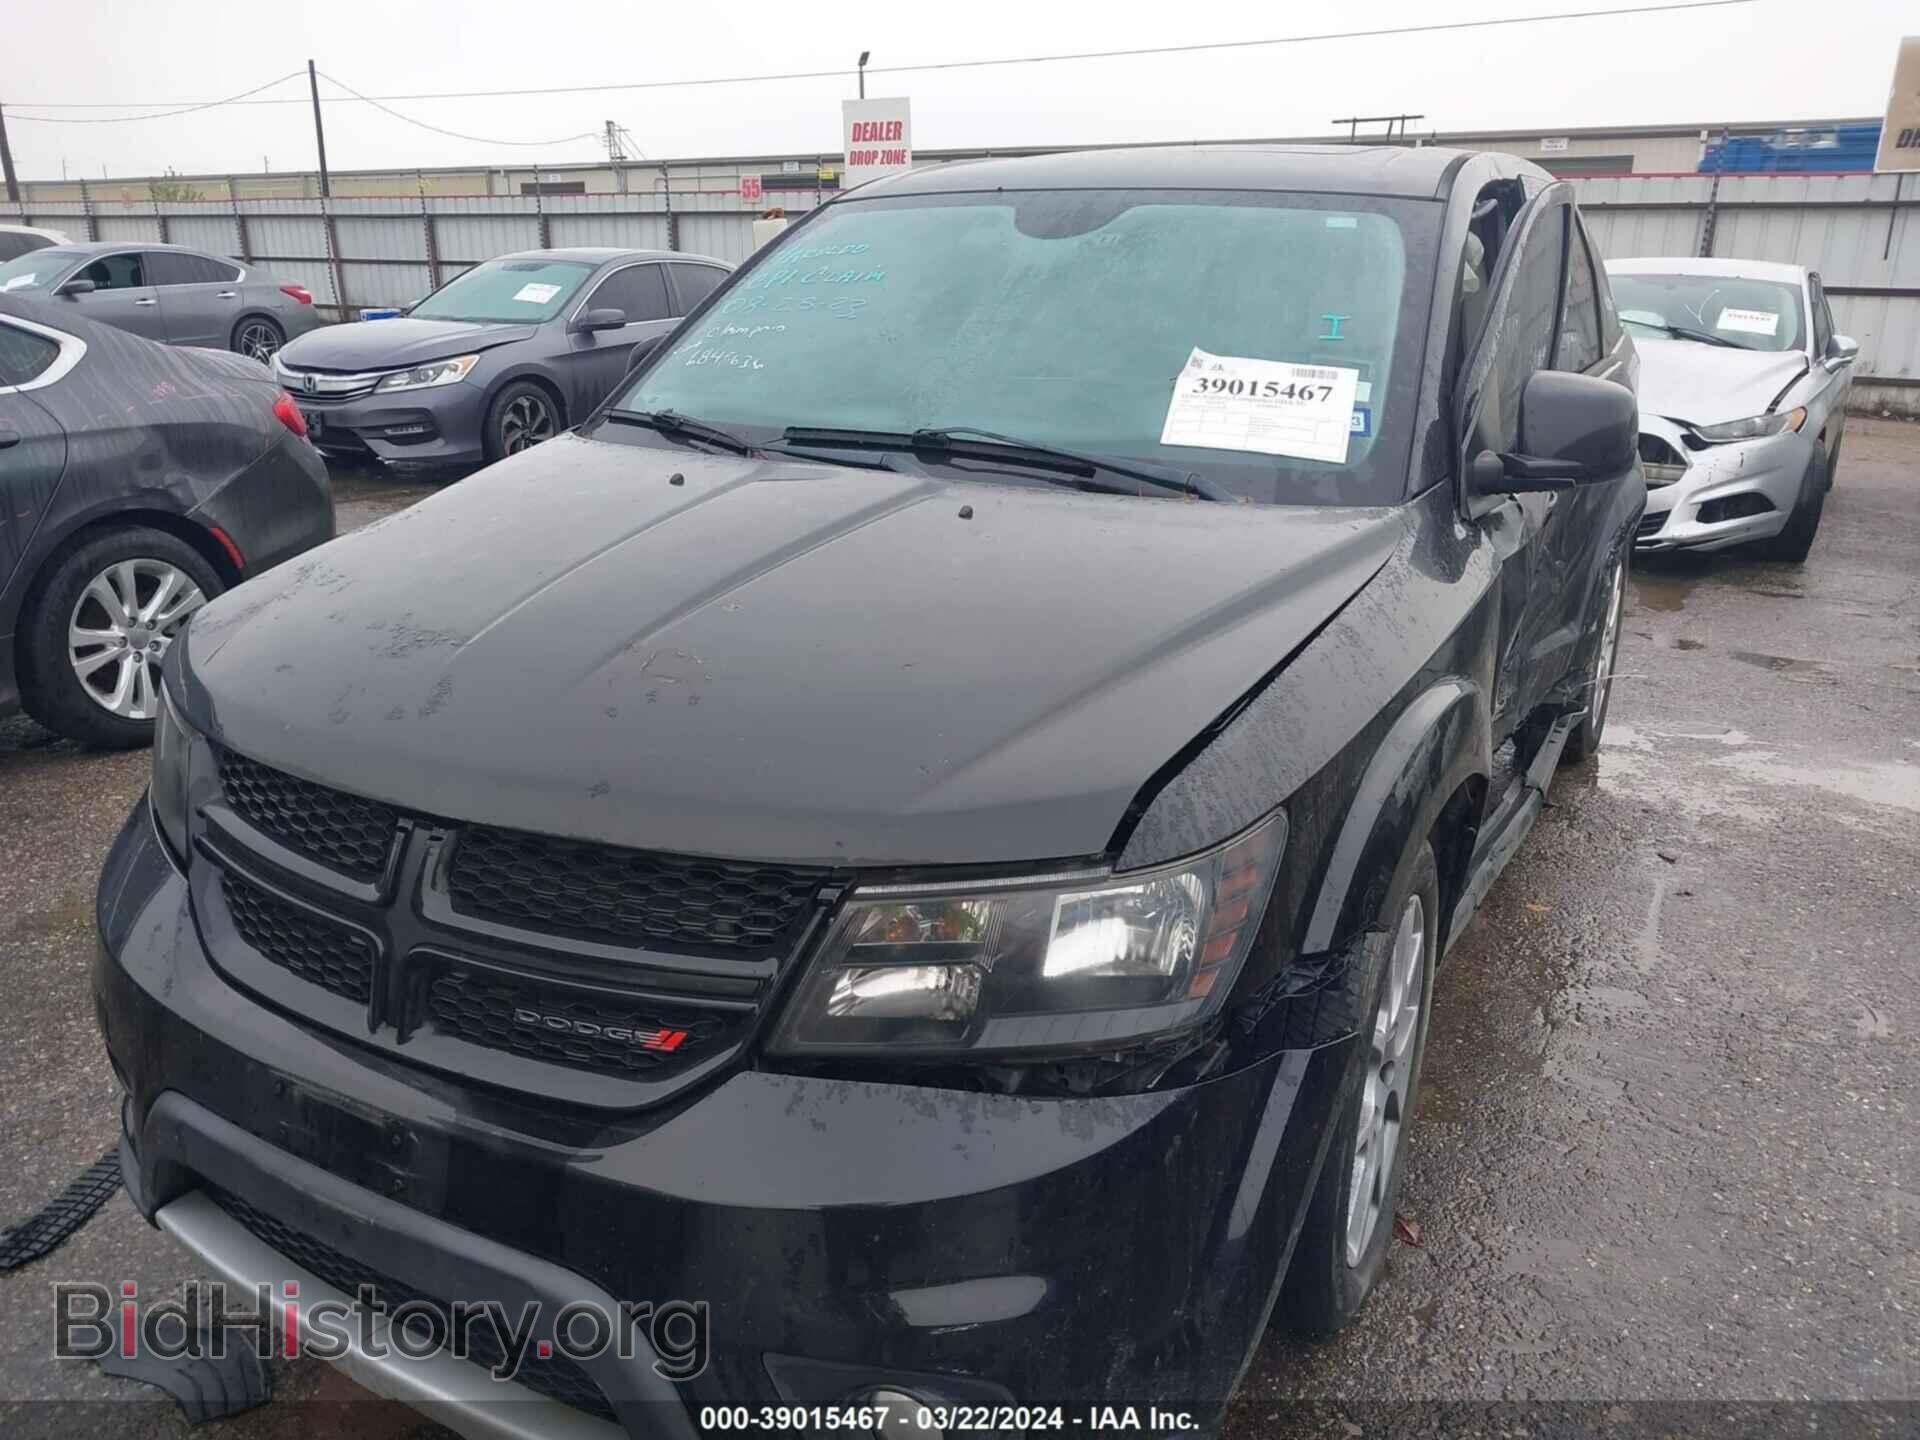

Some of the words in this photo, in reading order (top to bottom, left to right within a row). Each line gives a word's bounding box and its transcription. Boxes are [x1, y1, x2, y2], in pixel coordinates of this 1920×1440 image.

[852, 121, 902, 142] DEALER
[850, 150, 876, 165] DROP
[880, 149, 907, 165] ZONE
[742, 178, 760, 198] 55
[1192, 377, 1333, 403] 39015467
[513, 1007, 662, 1045] DODGE
